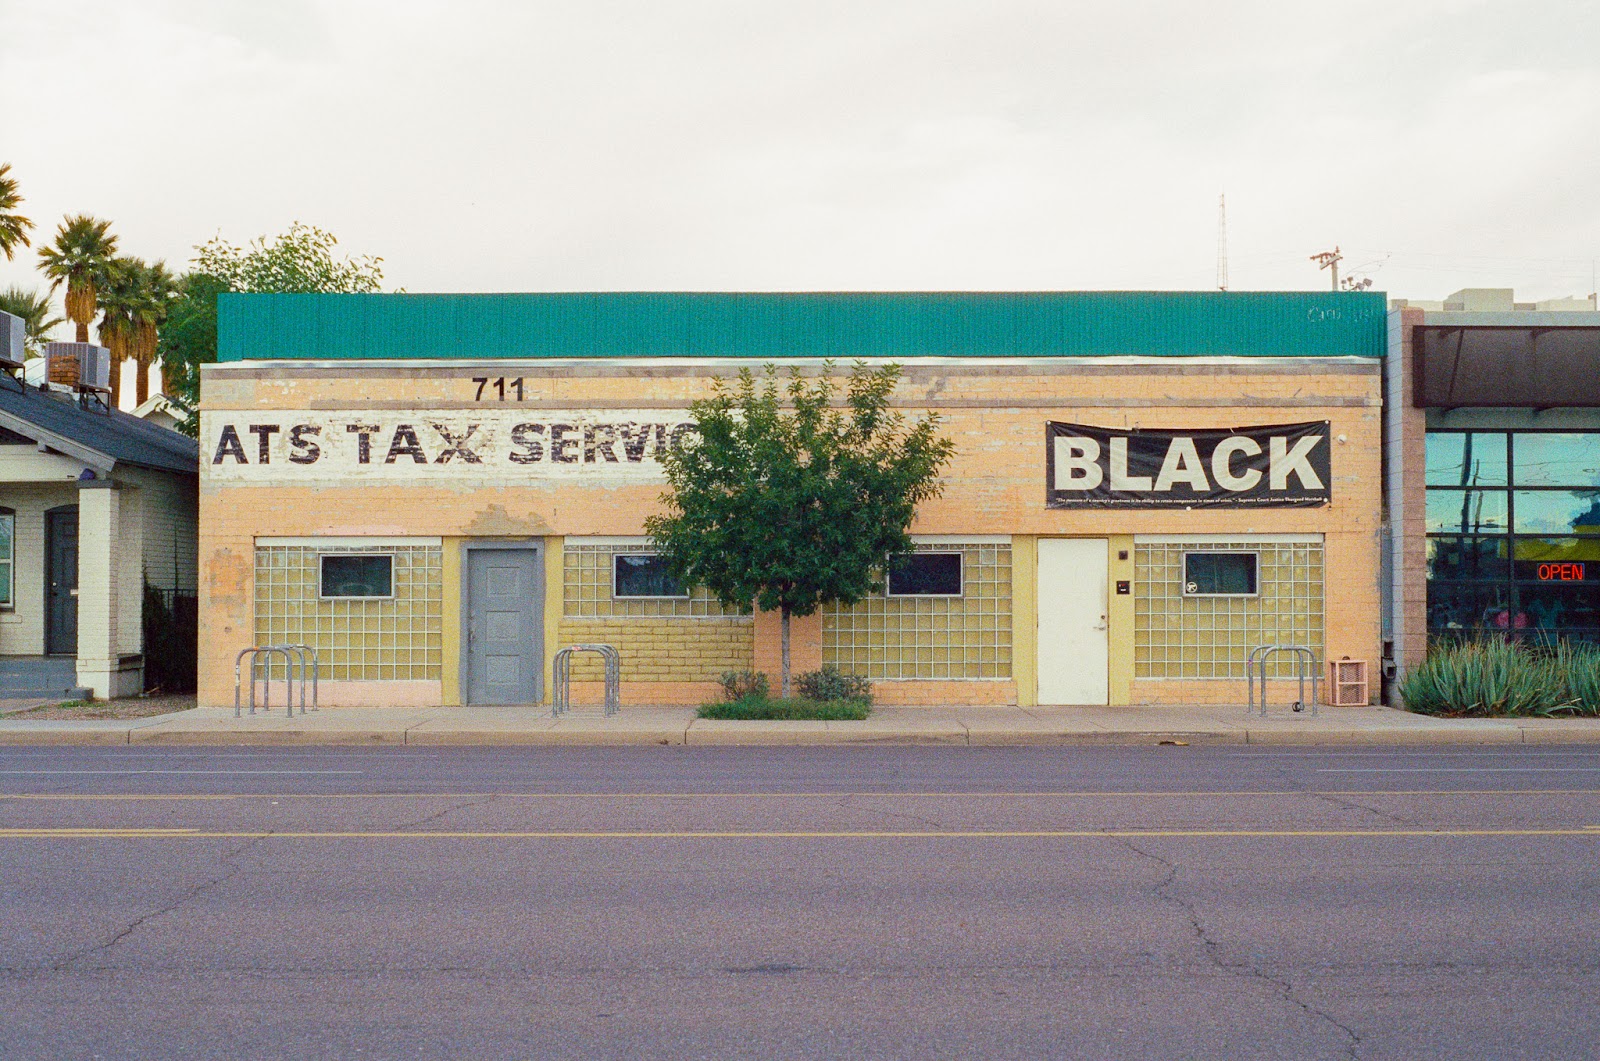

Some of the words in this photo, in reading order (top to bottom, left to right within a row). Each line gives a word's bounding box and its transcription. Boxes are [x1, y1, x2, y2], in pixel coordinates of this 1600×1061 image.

[472, 377, 524, 402] 711
[212, 423, 322, 465] ATS
[346, 423, 483, 464] TAX
[1054, 435, 1325, 491] BLACK
[1538, 563, 1583, 581] OPEN
